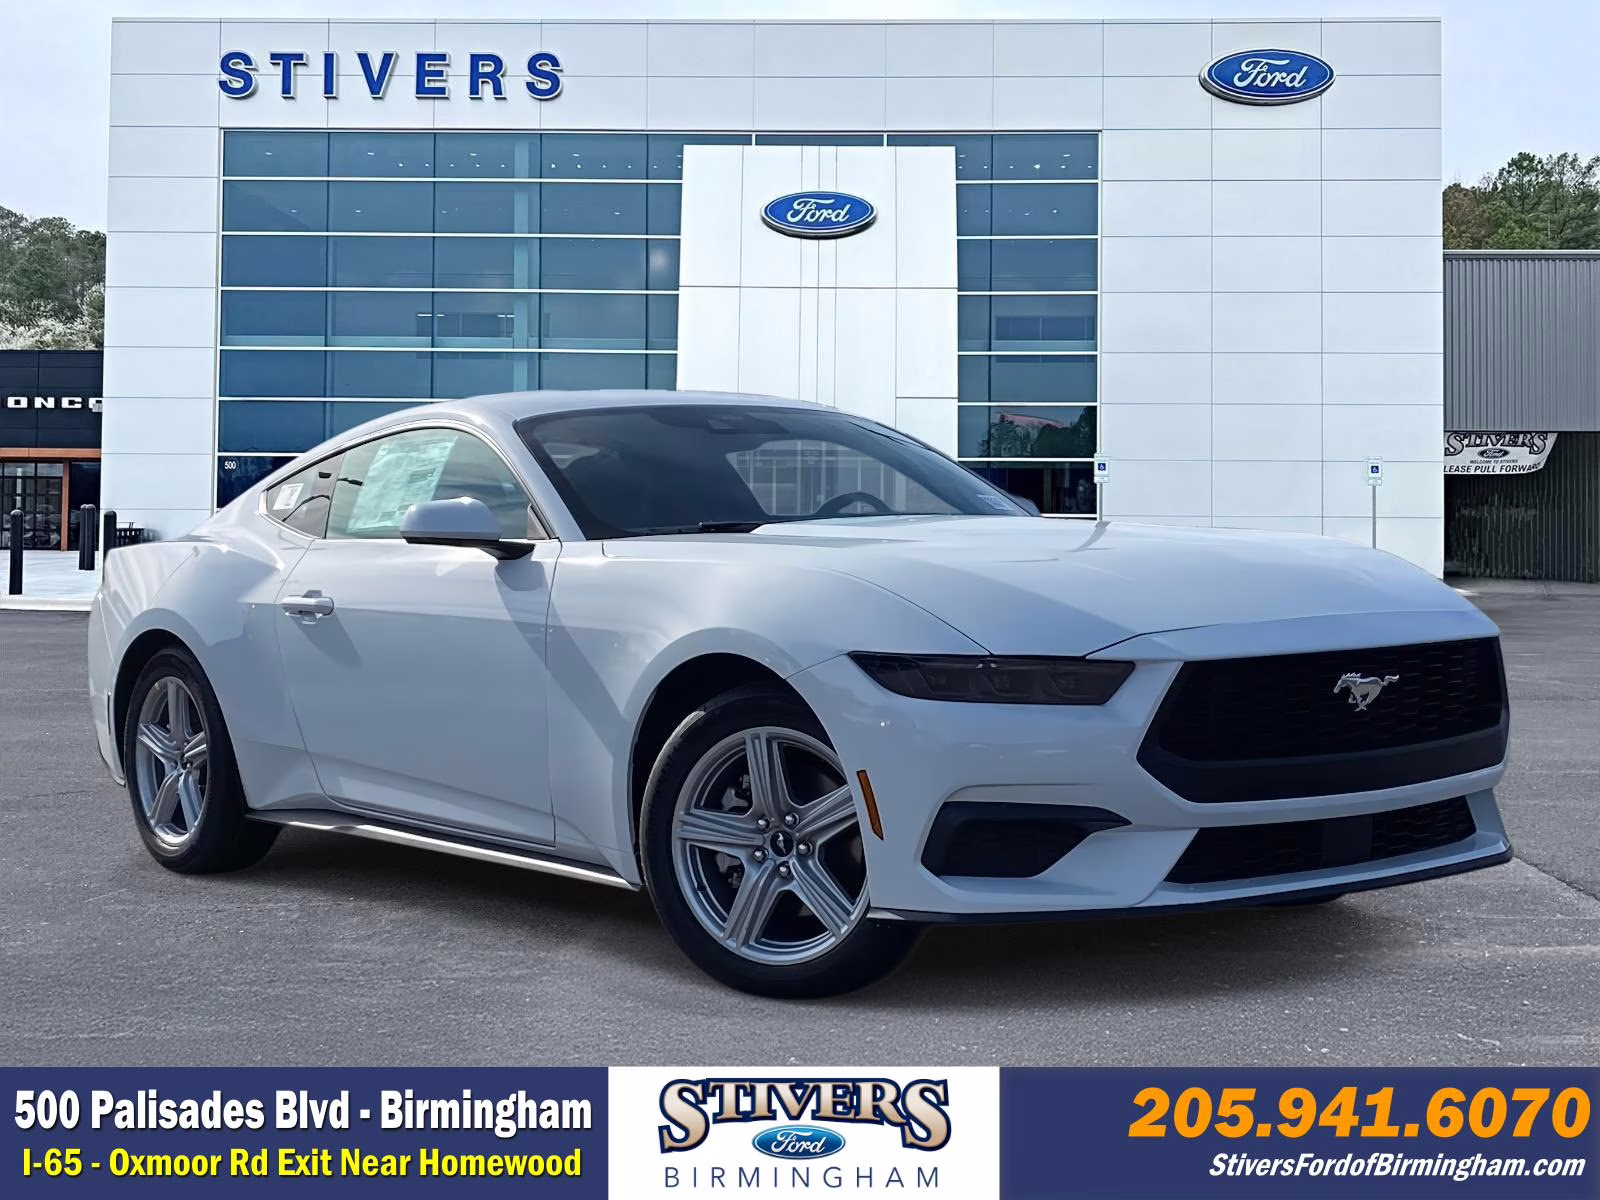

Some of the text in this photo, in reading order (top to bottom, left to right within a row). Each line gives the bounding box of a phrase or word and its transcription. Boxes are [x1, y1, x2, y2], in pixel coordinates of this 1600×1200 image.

[218, 51, 565, 101] STIVERS
[1233, 57, 1309, 88] Ford
[786, 197, 851, 223] Ford
[1444, 431, 1548, 456] STIVERS
[224, 460, 236, 470] 500
[1474, 465, 1497, 473] PULL
